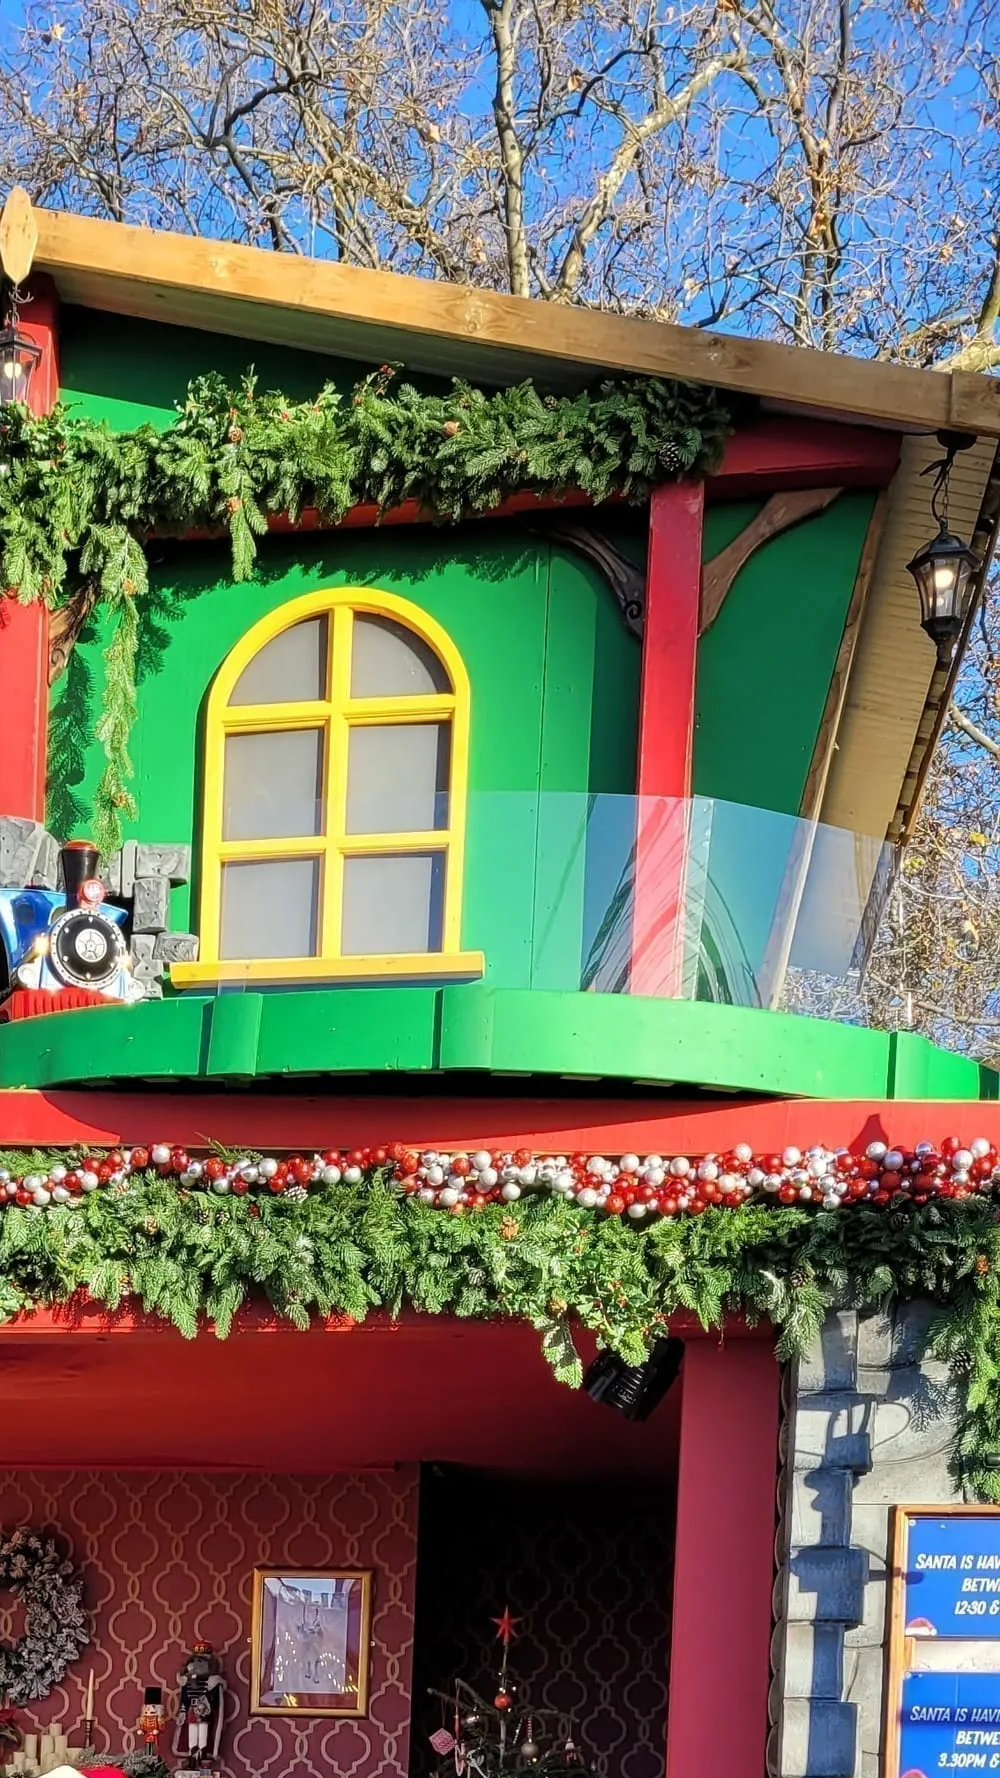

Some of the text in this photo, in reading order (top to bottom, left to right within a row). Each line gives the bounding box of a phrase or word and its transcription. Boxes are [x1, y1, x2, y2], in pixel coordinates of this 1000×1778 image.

[915, 1553, 957, 1569] SANTA
[960, 1554, 974, 1569] IS
[954, 1600, 987, 1615] 12:30
[910, 1705, 1000, 1722] SANTA IS HAVI
[937, 1752, 987, 1768] 3.30PM
